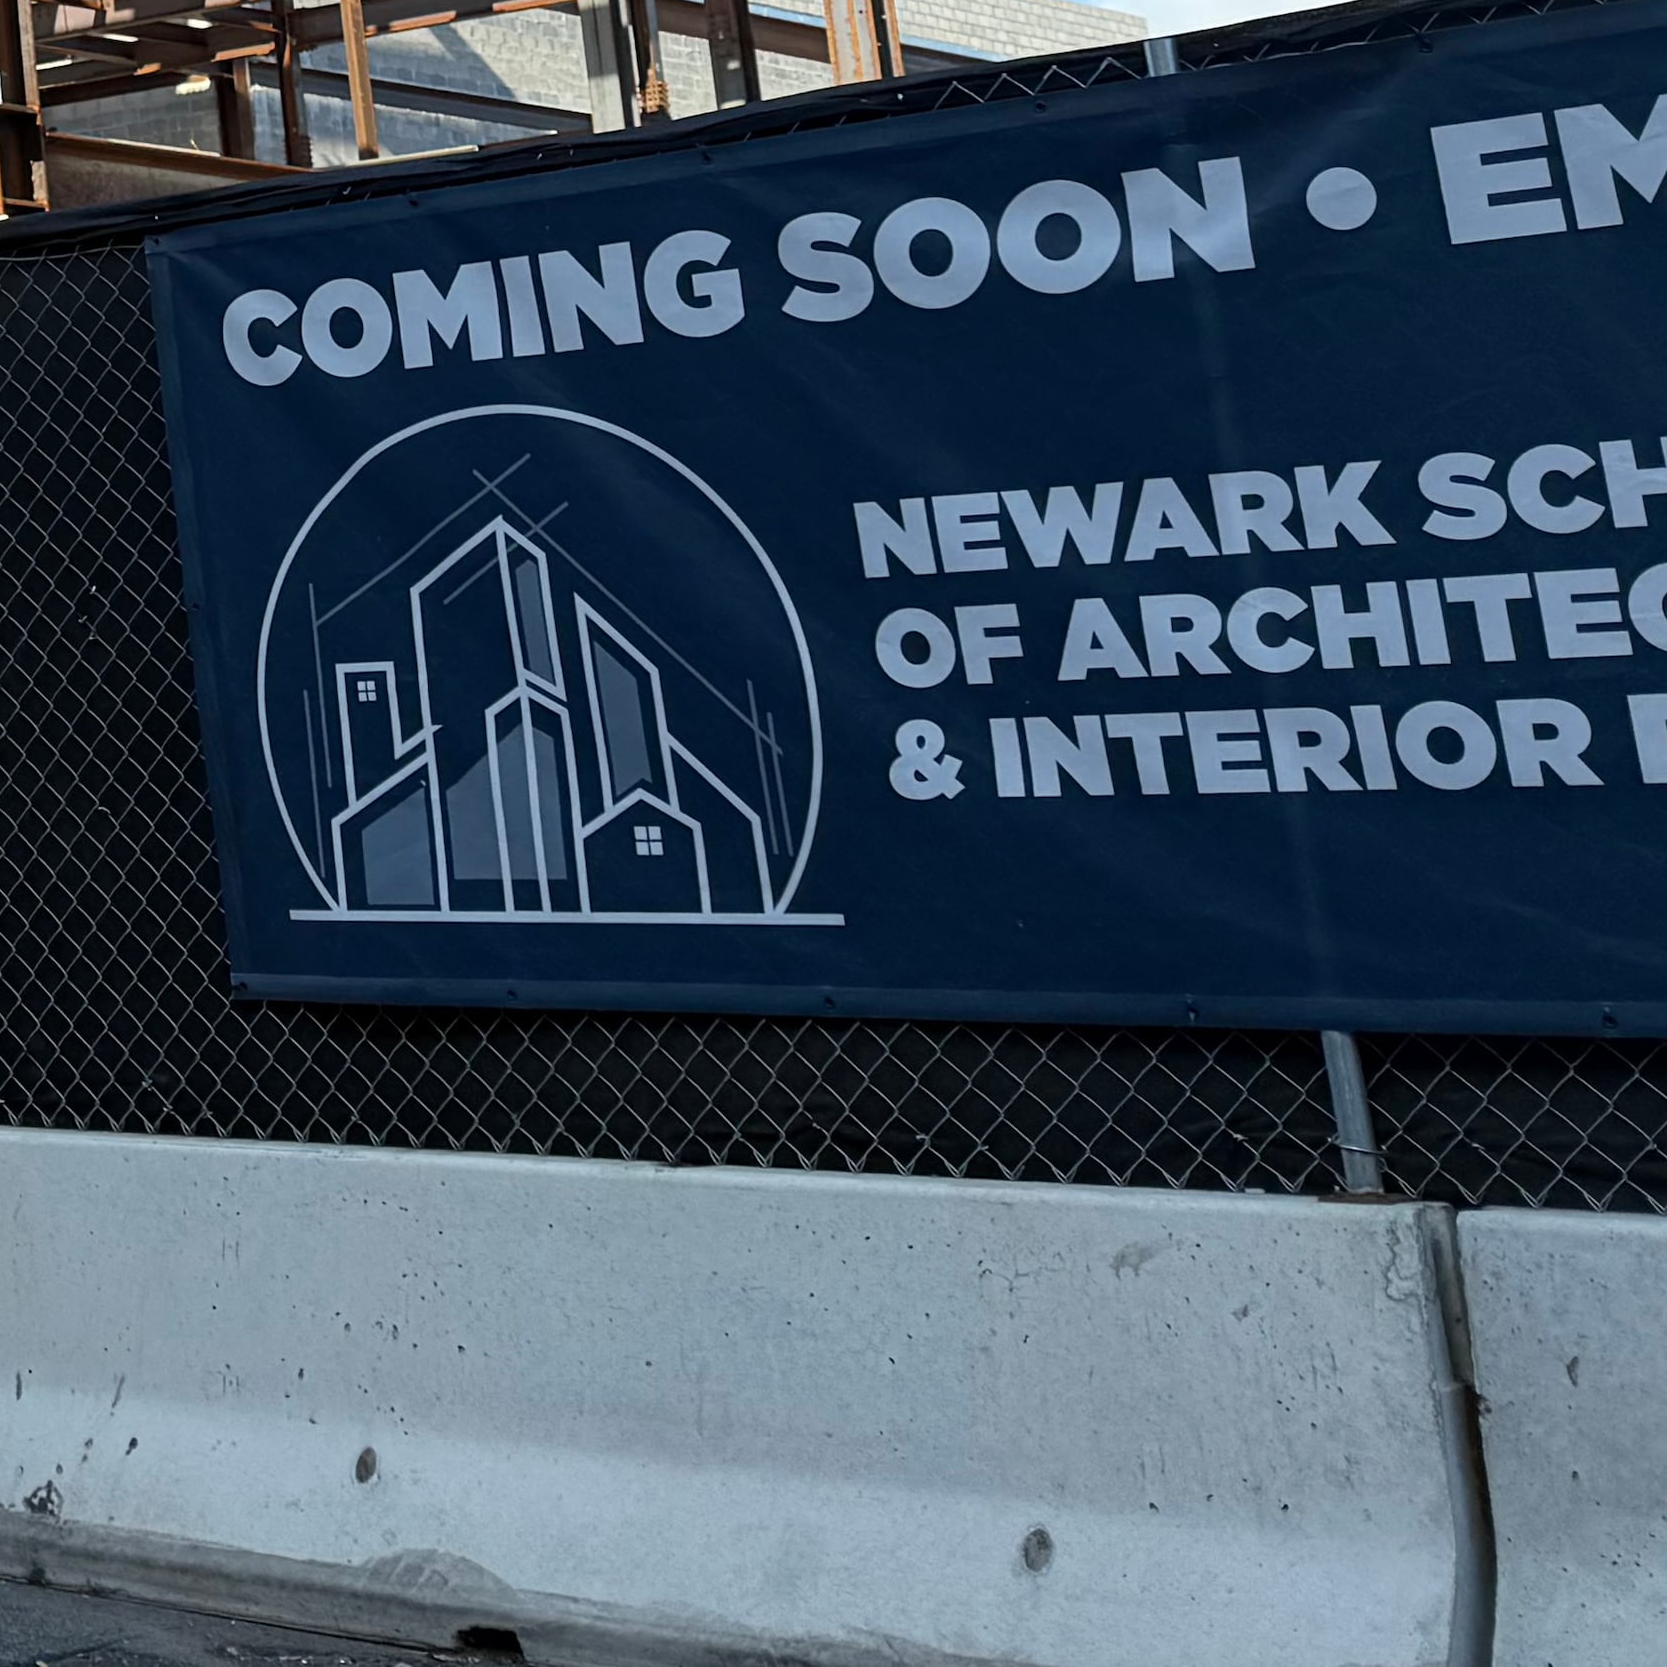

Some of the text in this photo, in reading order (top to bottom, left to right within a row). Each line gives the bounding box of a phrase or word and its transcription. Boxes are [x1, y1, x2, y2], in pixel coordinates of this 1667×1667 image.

[223, 95, 1667, 387] COMING SOON EM
[853, 460, 1397, 578] NEWARK
[875, 603, 1024, 688] OF
[888, 718, 965, 800] &
[989, 698, 1605, 798] INTERIOR
